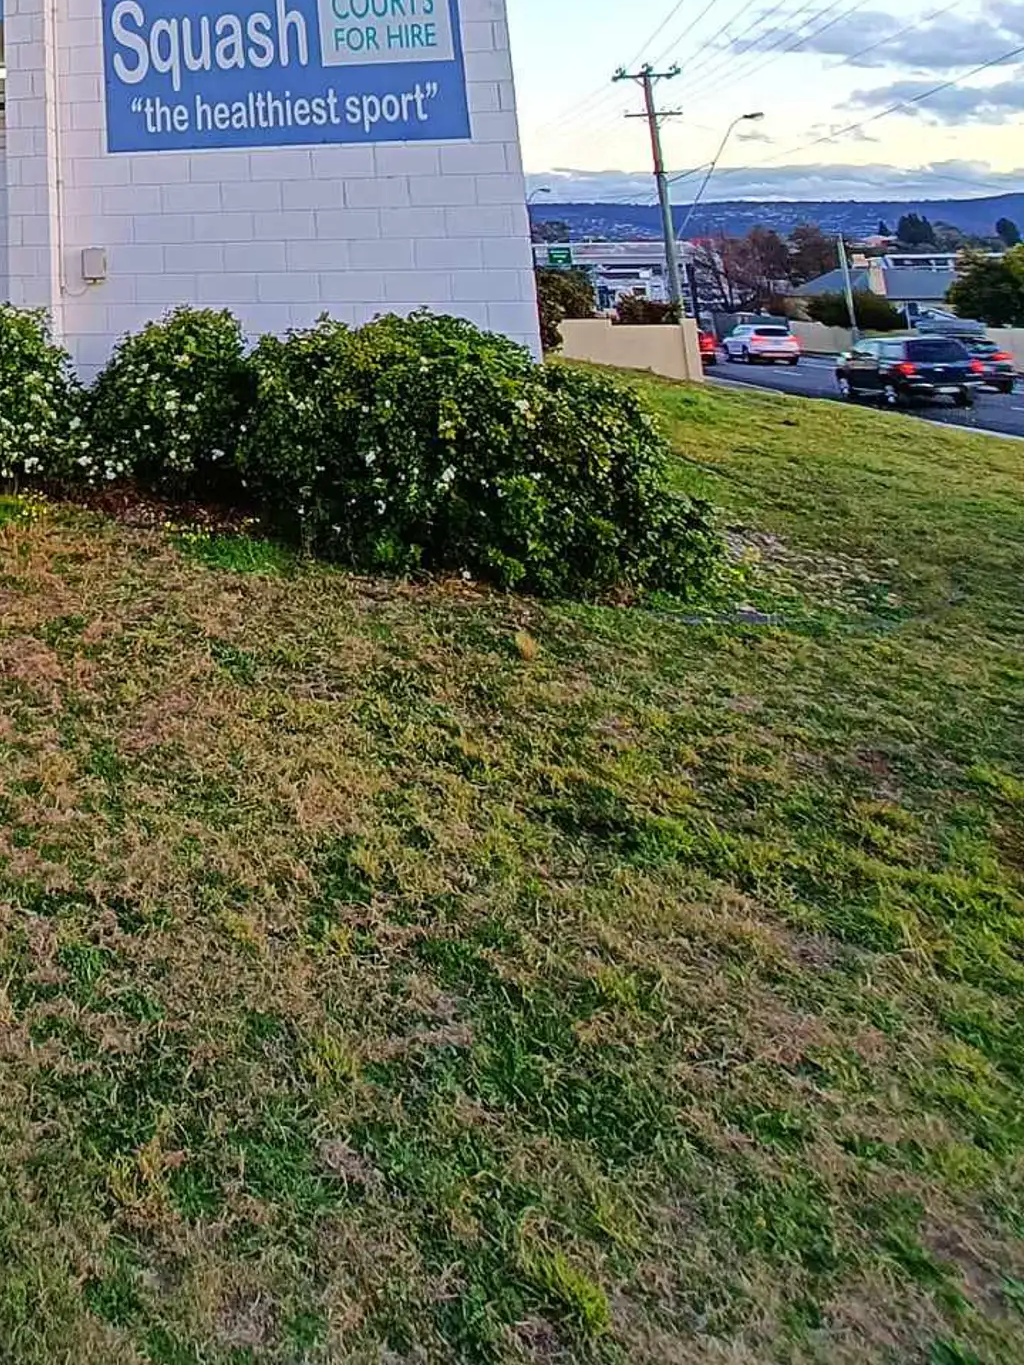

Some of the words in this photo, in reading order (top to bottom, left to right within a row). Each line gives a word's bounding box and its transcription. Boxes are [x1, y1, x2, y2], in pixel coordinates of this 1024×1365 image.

[334, 27, 379, 51] FOR
[386, 23, 437, 49] HIRE
[131, 97, 189, 132] “the
[195, 89, 340, 130] healthiest
[345, 82, 438, 133] sport”
